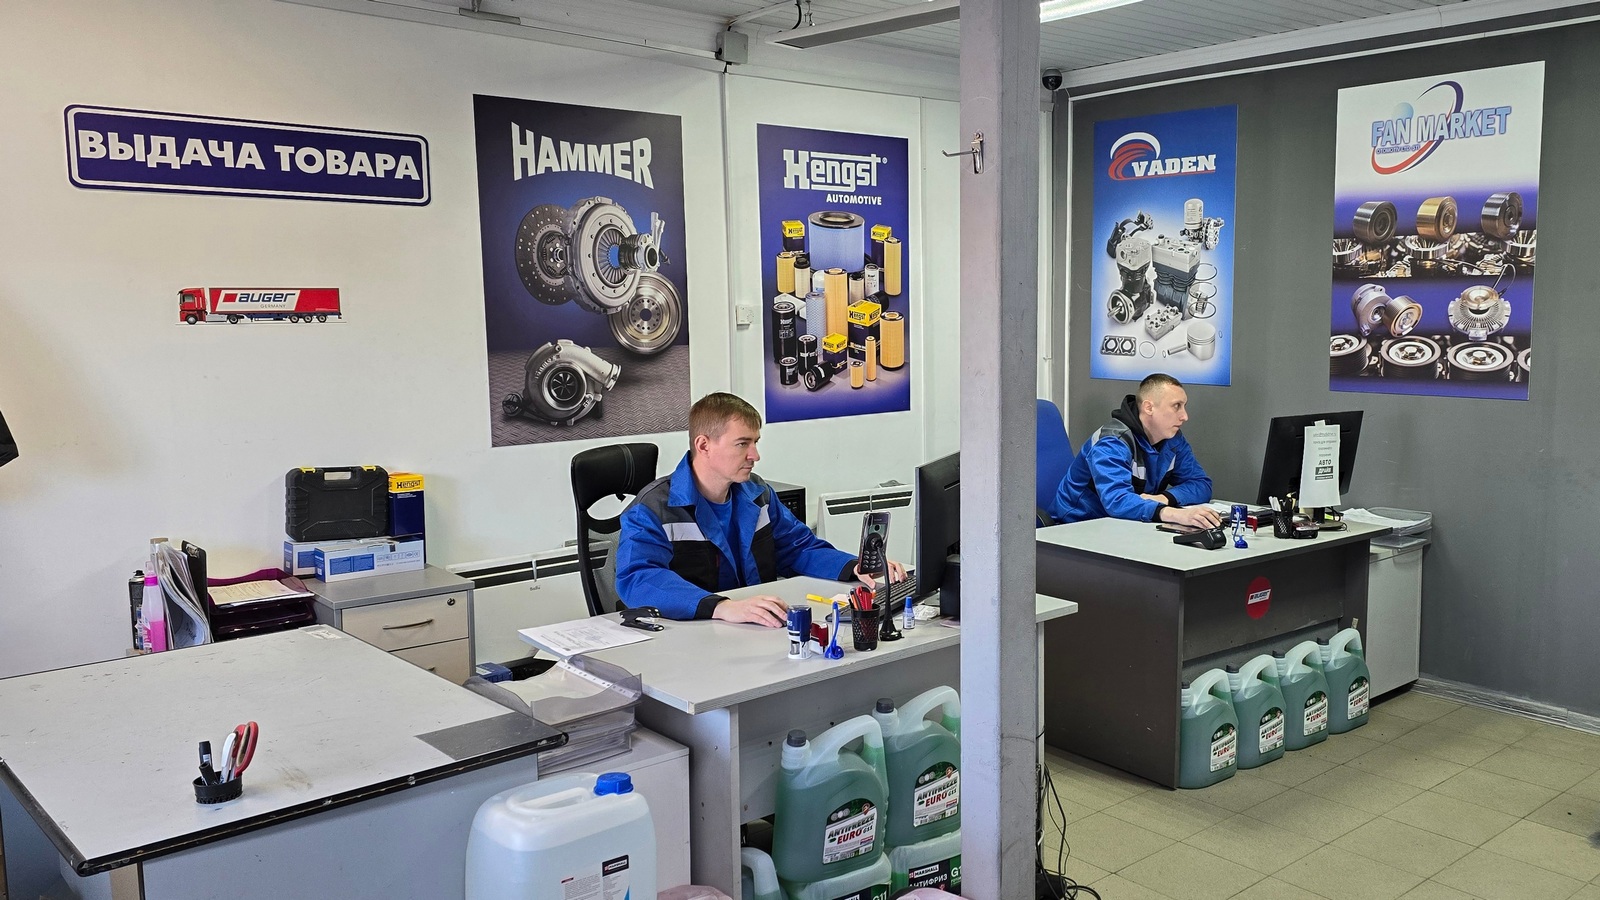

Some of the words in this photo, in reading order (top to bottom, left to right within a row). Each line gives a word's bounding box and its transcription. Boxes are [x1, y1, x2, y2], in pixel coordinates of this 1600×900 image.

[1371, 117, 1412, 147] FAN
[1417, 106, 1512, 143] MARKET
[78, 129, 266, 171] ВЫДАЧА
[274, 145, 421, 181] ТОВАРА
[511, 121, 654, 190] HAMMER
[783, 149, 881, 192] Hengst
[1131, 154, 1217, 177] VADEN
[826, 193, 882, 206] AUTOMOTIVE
[396, 480, 421, 489] Hengst
[925, 792, 948, 807] EURO
[837, 829, 863, 844] EURO
[915, 866, 938, 876] MARSHALL
